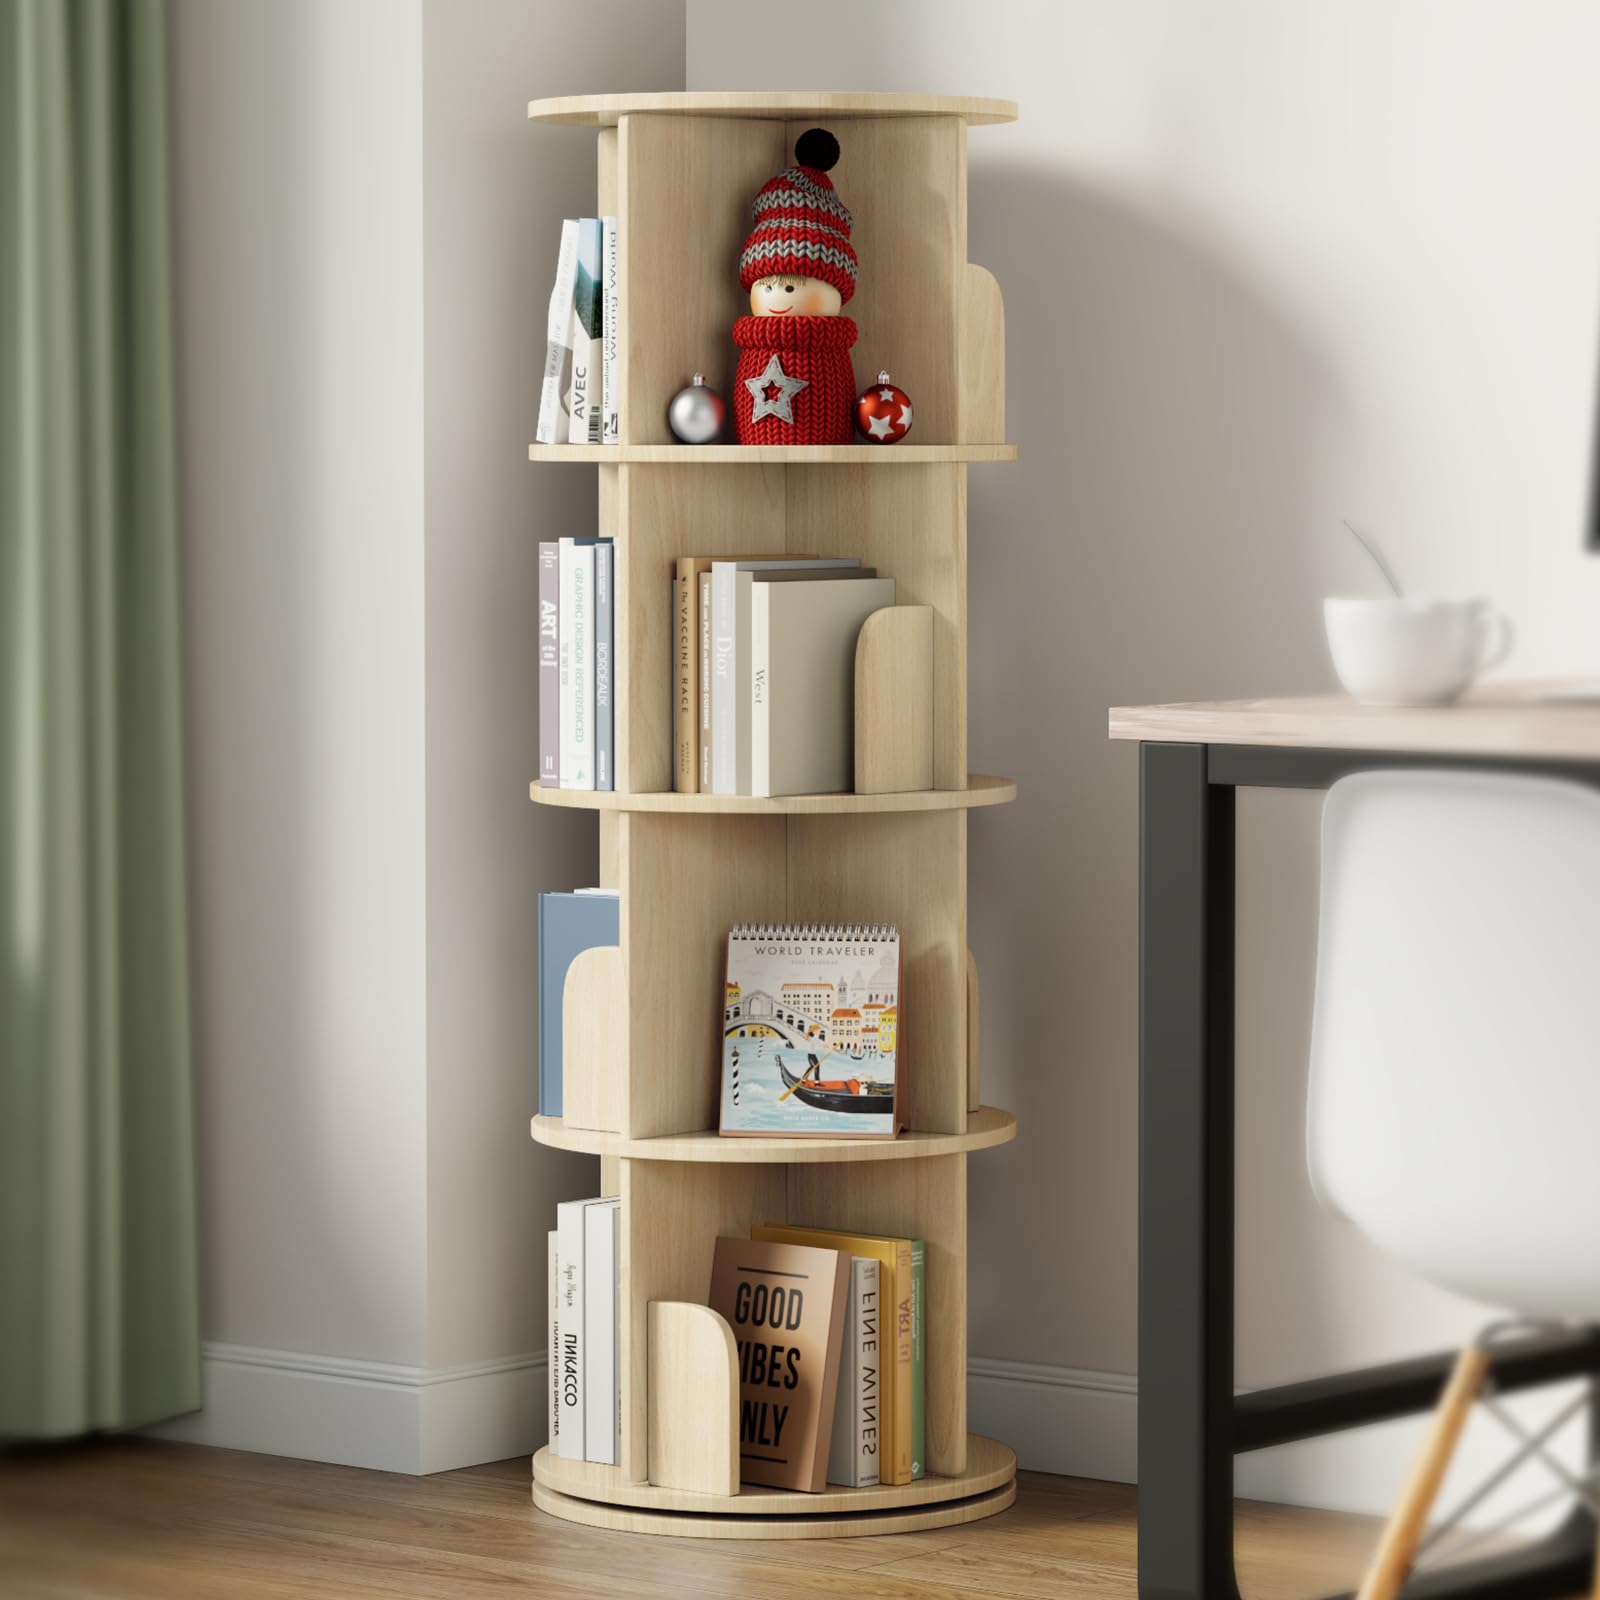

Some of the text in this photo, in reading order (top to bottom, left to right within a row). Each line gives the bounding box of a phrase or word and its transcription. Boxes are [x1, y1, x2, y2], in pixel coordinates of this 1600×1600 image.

[574, 366, 587, 419] AVEC
[542, 600, 558, 638] ART
[576, 568, 584, 743] GRAPHIC DESIGN REFERENCED
[598, 642, 608, 706] BORDEAUX
[716, 636, 732, 680] Dior
[754, 669, 766, 704] West
[754, 946, 875, 956] WORLD TRAVELER
[734, 1281, 803, 1331] GOOD
[564, 1333, 577, 1407] ПИКАССО
[738, 1342, 801, 1390] IBES
[740, 1400, 788, 1448] NLY
